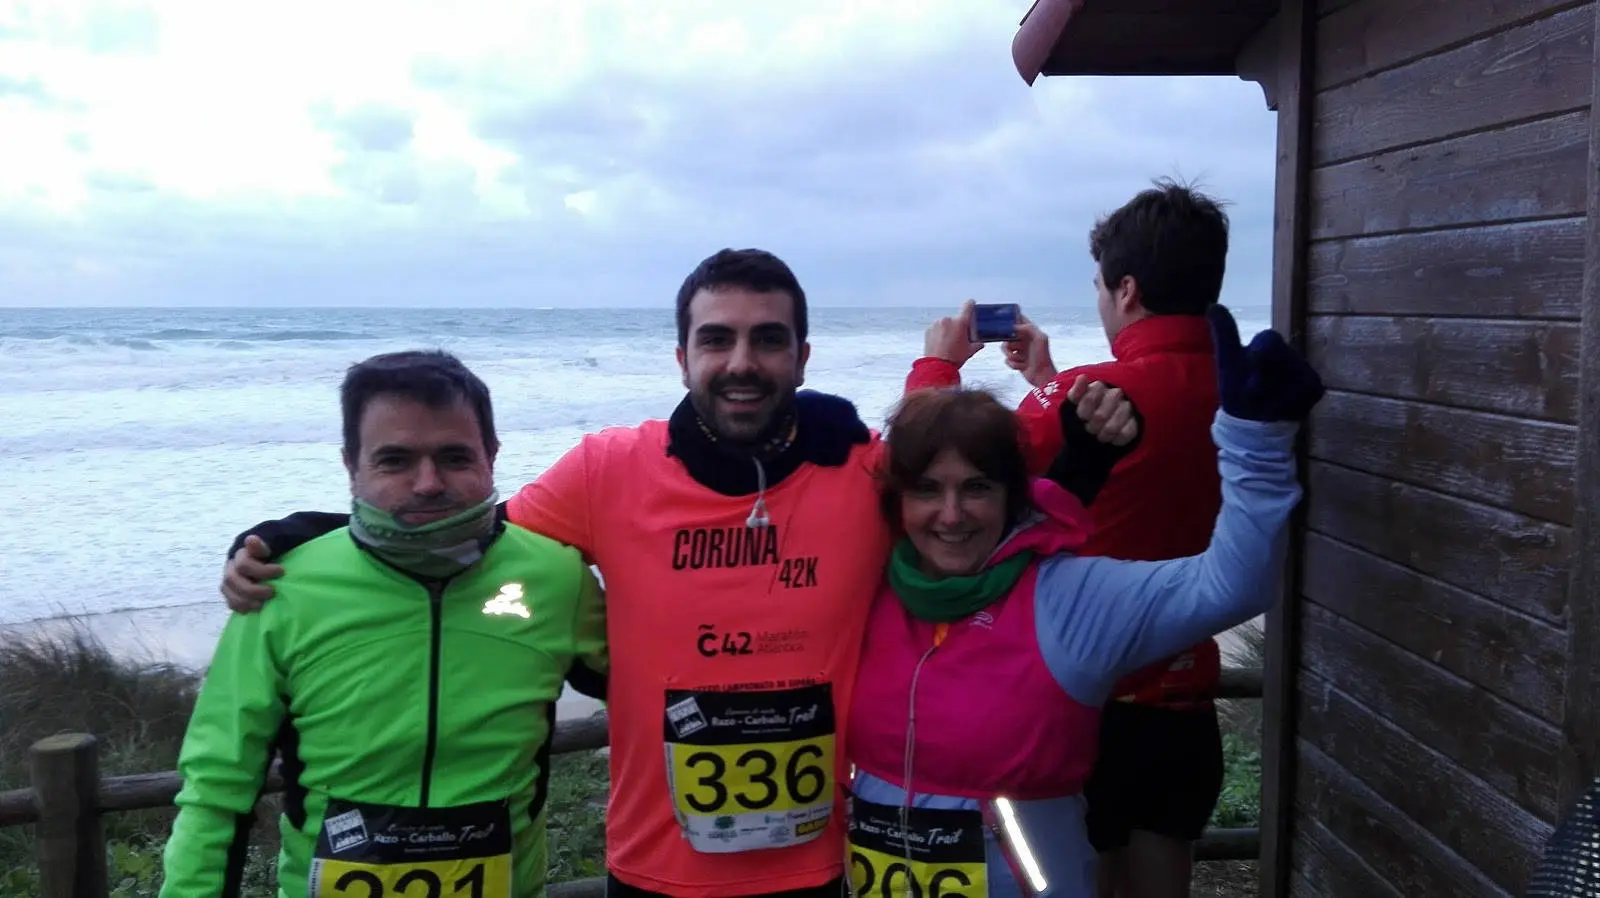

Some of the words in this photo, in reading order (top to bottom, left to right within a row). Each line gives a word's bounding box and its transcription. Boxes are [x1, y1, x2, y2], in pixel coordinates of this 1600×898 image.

[779, 557, 819, 588] 42K
[711, 716, 736, 727] Razo
[744, 714, 787, 725] Carballo
[788, 704, 819, 726] Trail
[684, 745, 825, 814] 336
[409, 831, 456, 844] Carballo
[927, 827, 964, 847] Trail
